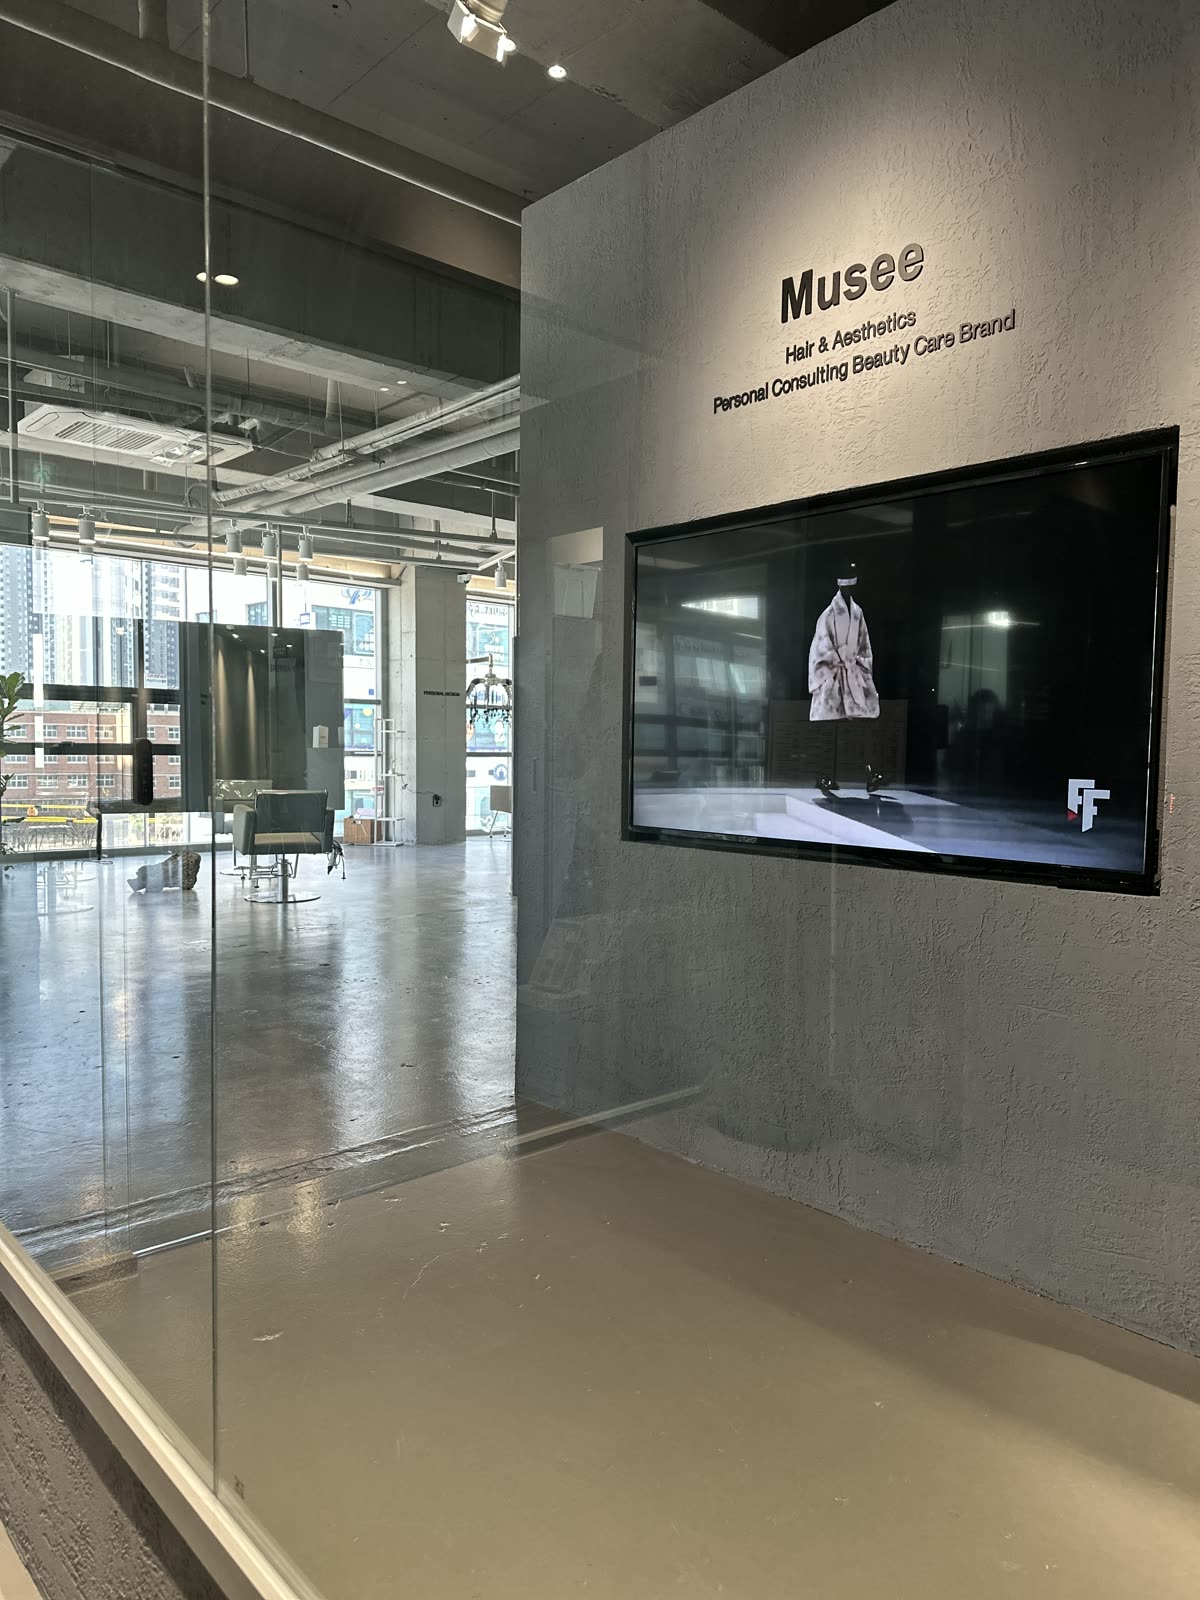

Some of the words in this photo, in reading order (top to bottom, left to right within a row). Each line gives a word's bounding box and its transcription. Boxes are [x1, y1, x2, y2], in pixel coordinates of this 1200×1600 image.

[781, 243, 924, 324] Musee
[713, 382, 769, 414] Personal
[771, 361, 849, 397] Consulting
[852, 343, 911, 374] Beauty
[914, 334, 955, 356] Care
[959, 308, 1016, 344] Brand
[786, 341, 815, 364] Hair
[818, 336, 829, 353] &
[832, 311, 917, 350] Aesthetics
